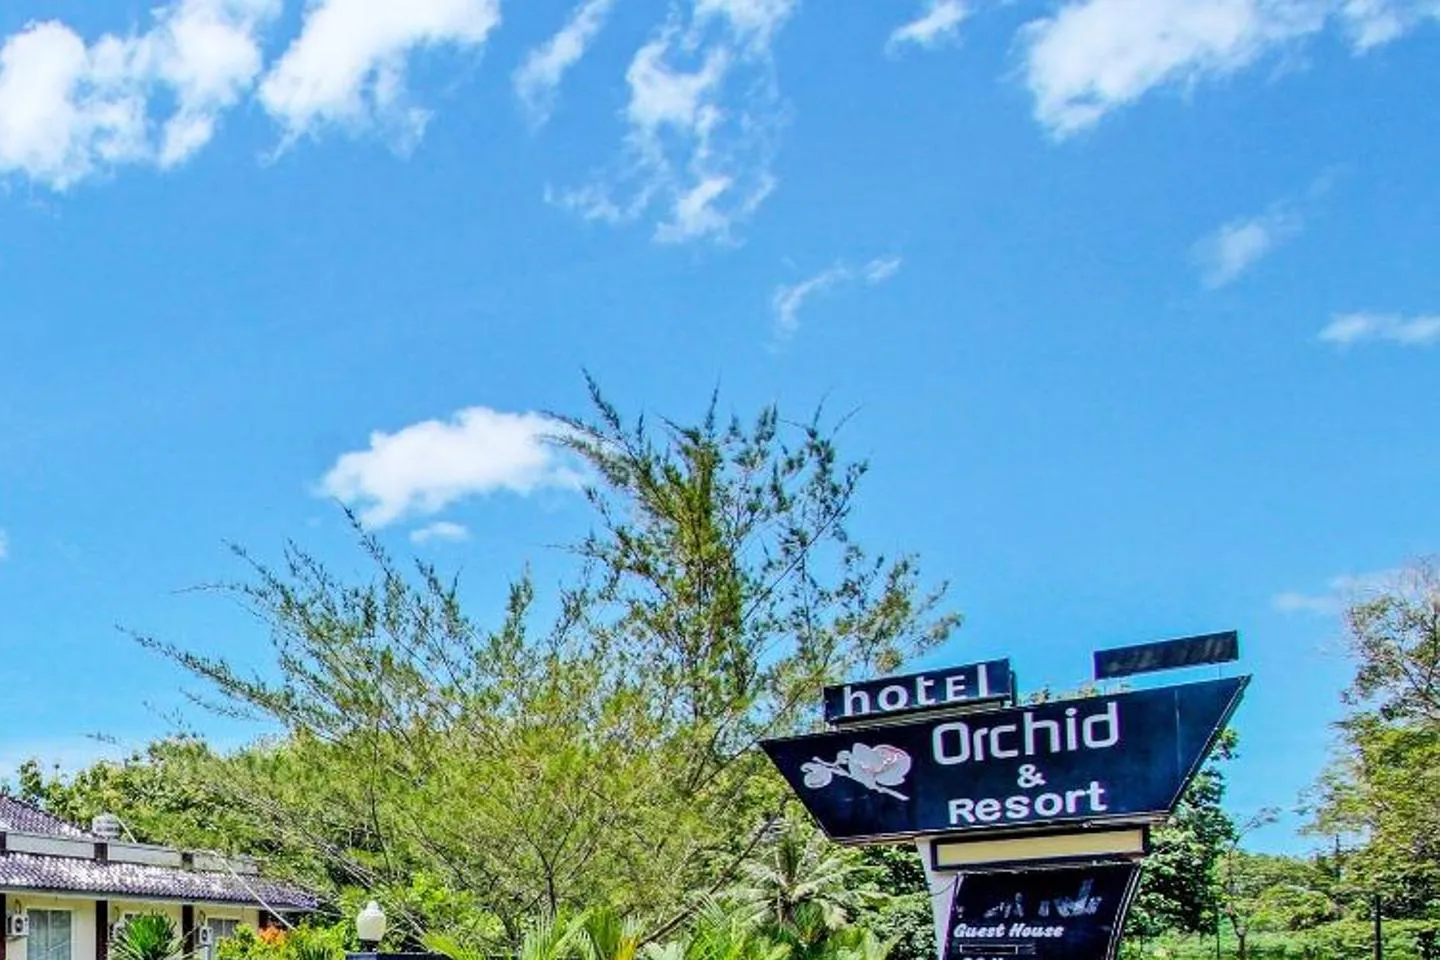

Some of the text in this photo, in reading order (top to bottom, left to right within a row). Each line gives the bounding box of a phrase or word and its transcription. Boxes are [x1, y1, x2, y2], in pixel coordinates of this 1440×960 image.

[933, 702, 1119, 765] Orchid
[1017, 764, 1047, 788] &
[948, 781, 1108, 824] Resort
[954, 923, 1065, 938] Guest House
